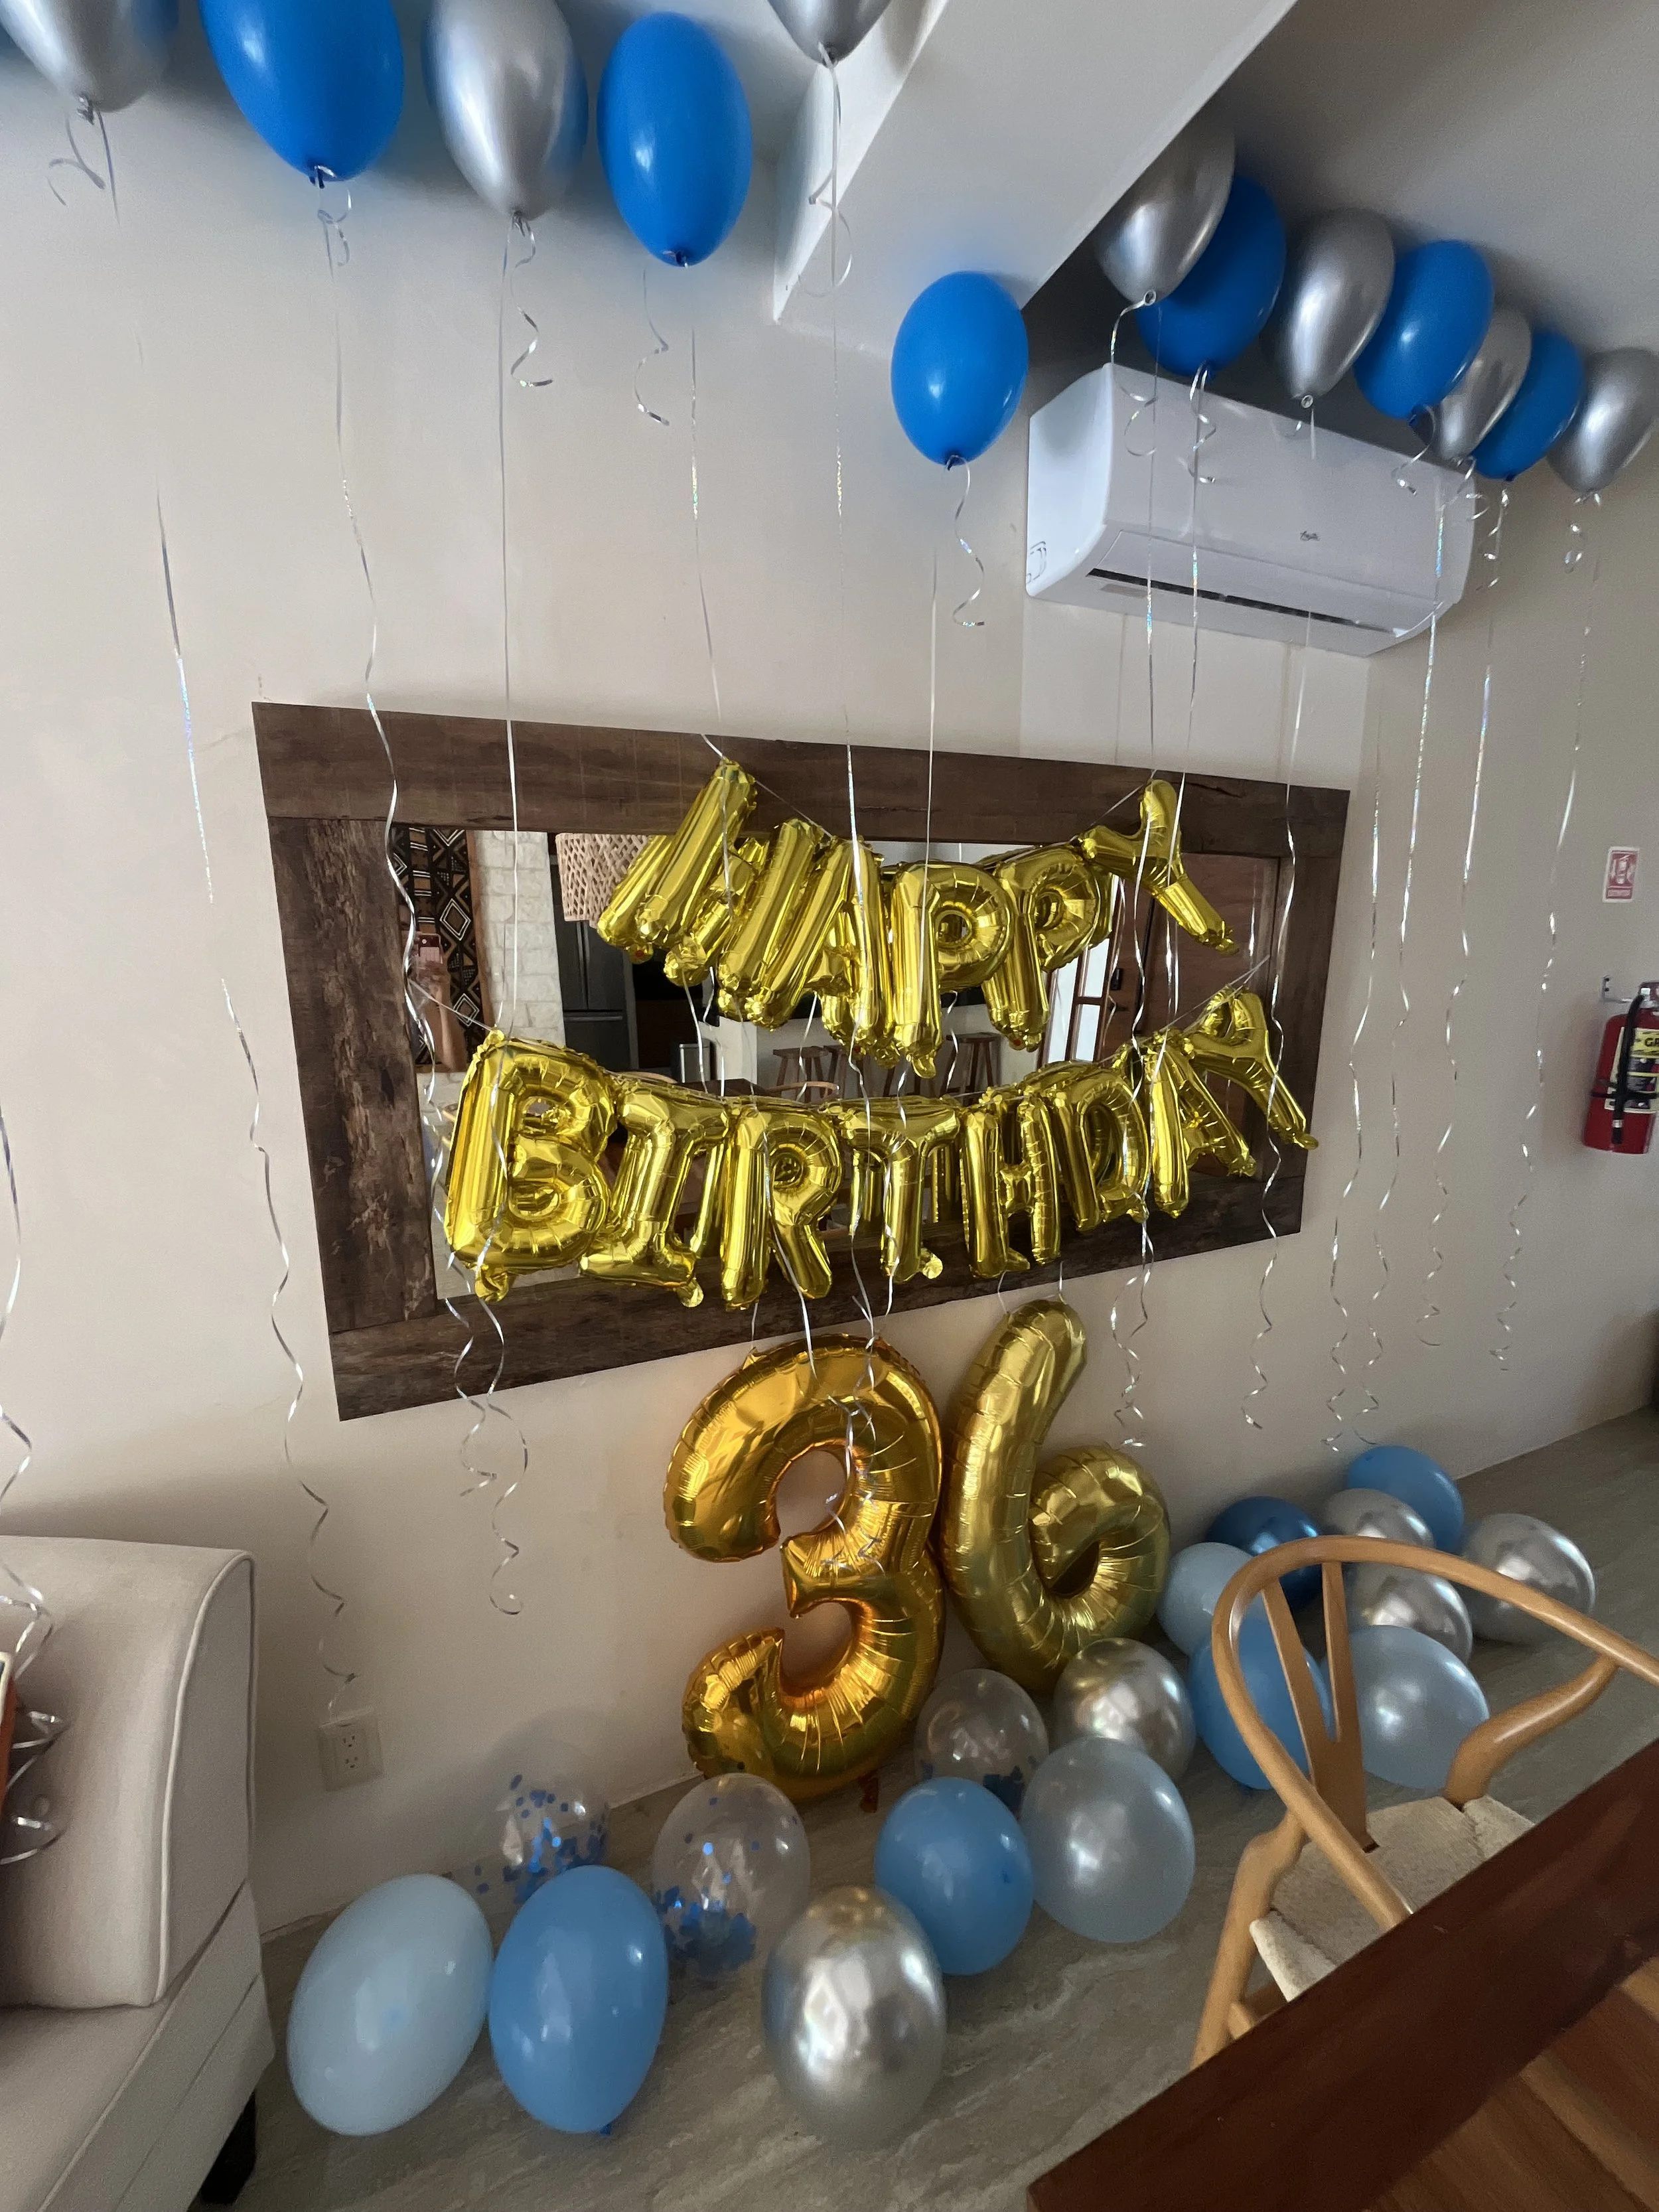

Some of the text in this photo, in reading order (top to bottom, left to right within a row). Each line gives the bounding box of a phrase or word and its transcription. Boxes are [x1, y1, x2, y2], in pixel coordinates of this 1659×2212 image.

[601, 758, 1238, 1076] HAPPY
[443, 988, 1319, 1310] BIRTHDAY
[664, 1299, 1171, 1800] 36
